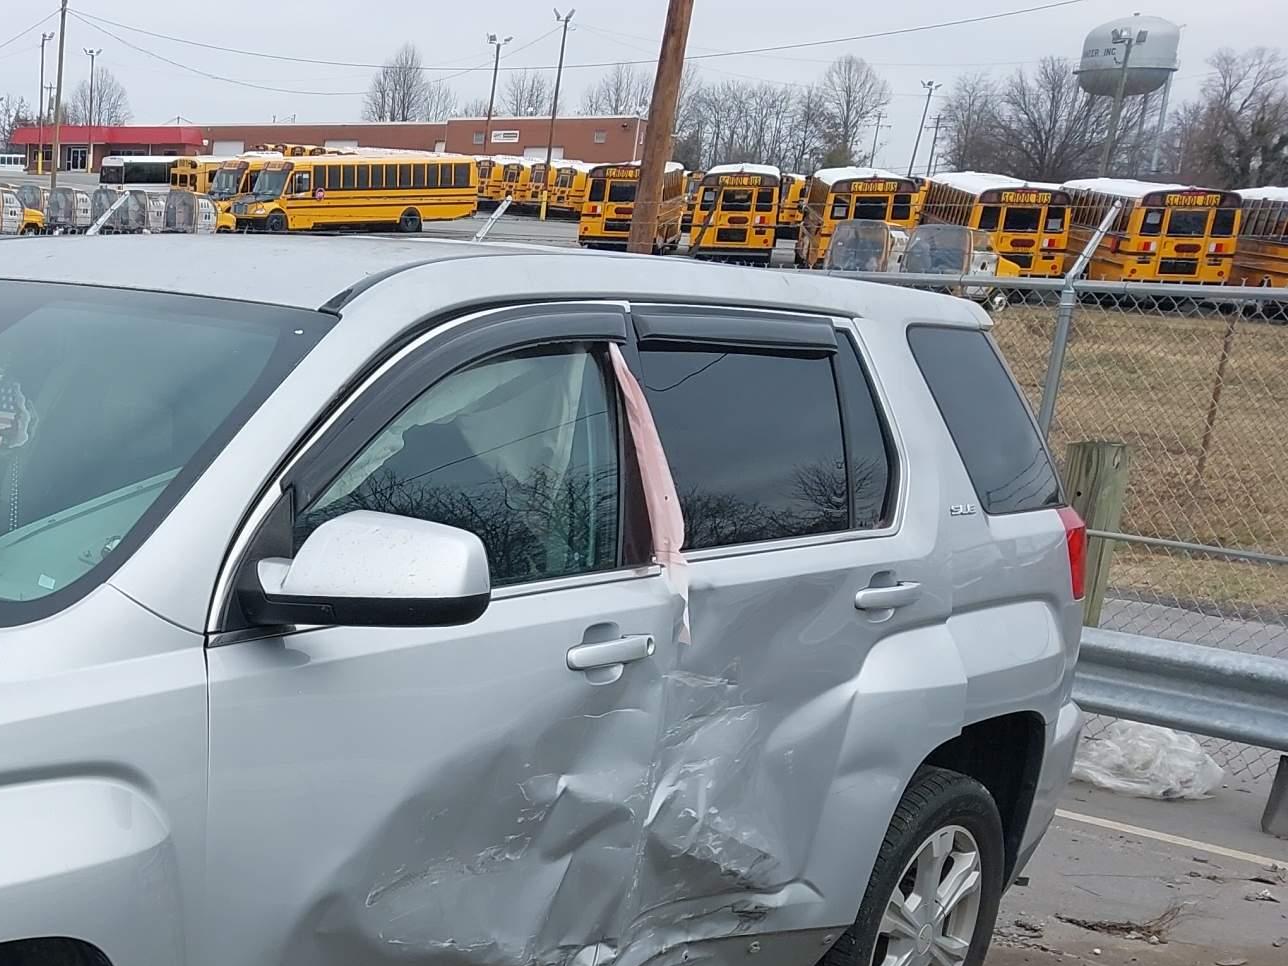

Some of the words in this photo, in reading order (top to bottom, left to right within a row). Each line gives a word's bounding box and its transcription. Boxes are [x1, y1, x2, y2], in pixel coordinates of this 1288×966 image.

[852, 182, 880, 192] SCHOOL
[883, 182, 897, 192] BUS
[1002, 192, 1032, 203] SCHOOL
[1035, 192, 1051, 204] BUS
[1166, 194, 1198, 206] SCHOOL
[1202, 194, 1220, 206] BUS
[950, 504, 976, 516] SLE
